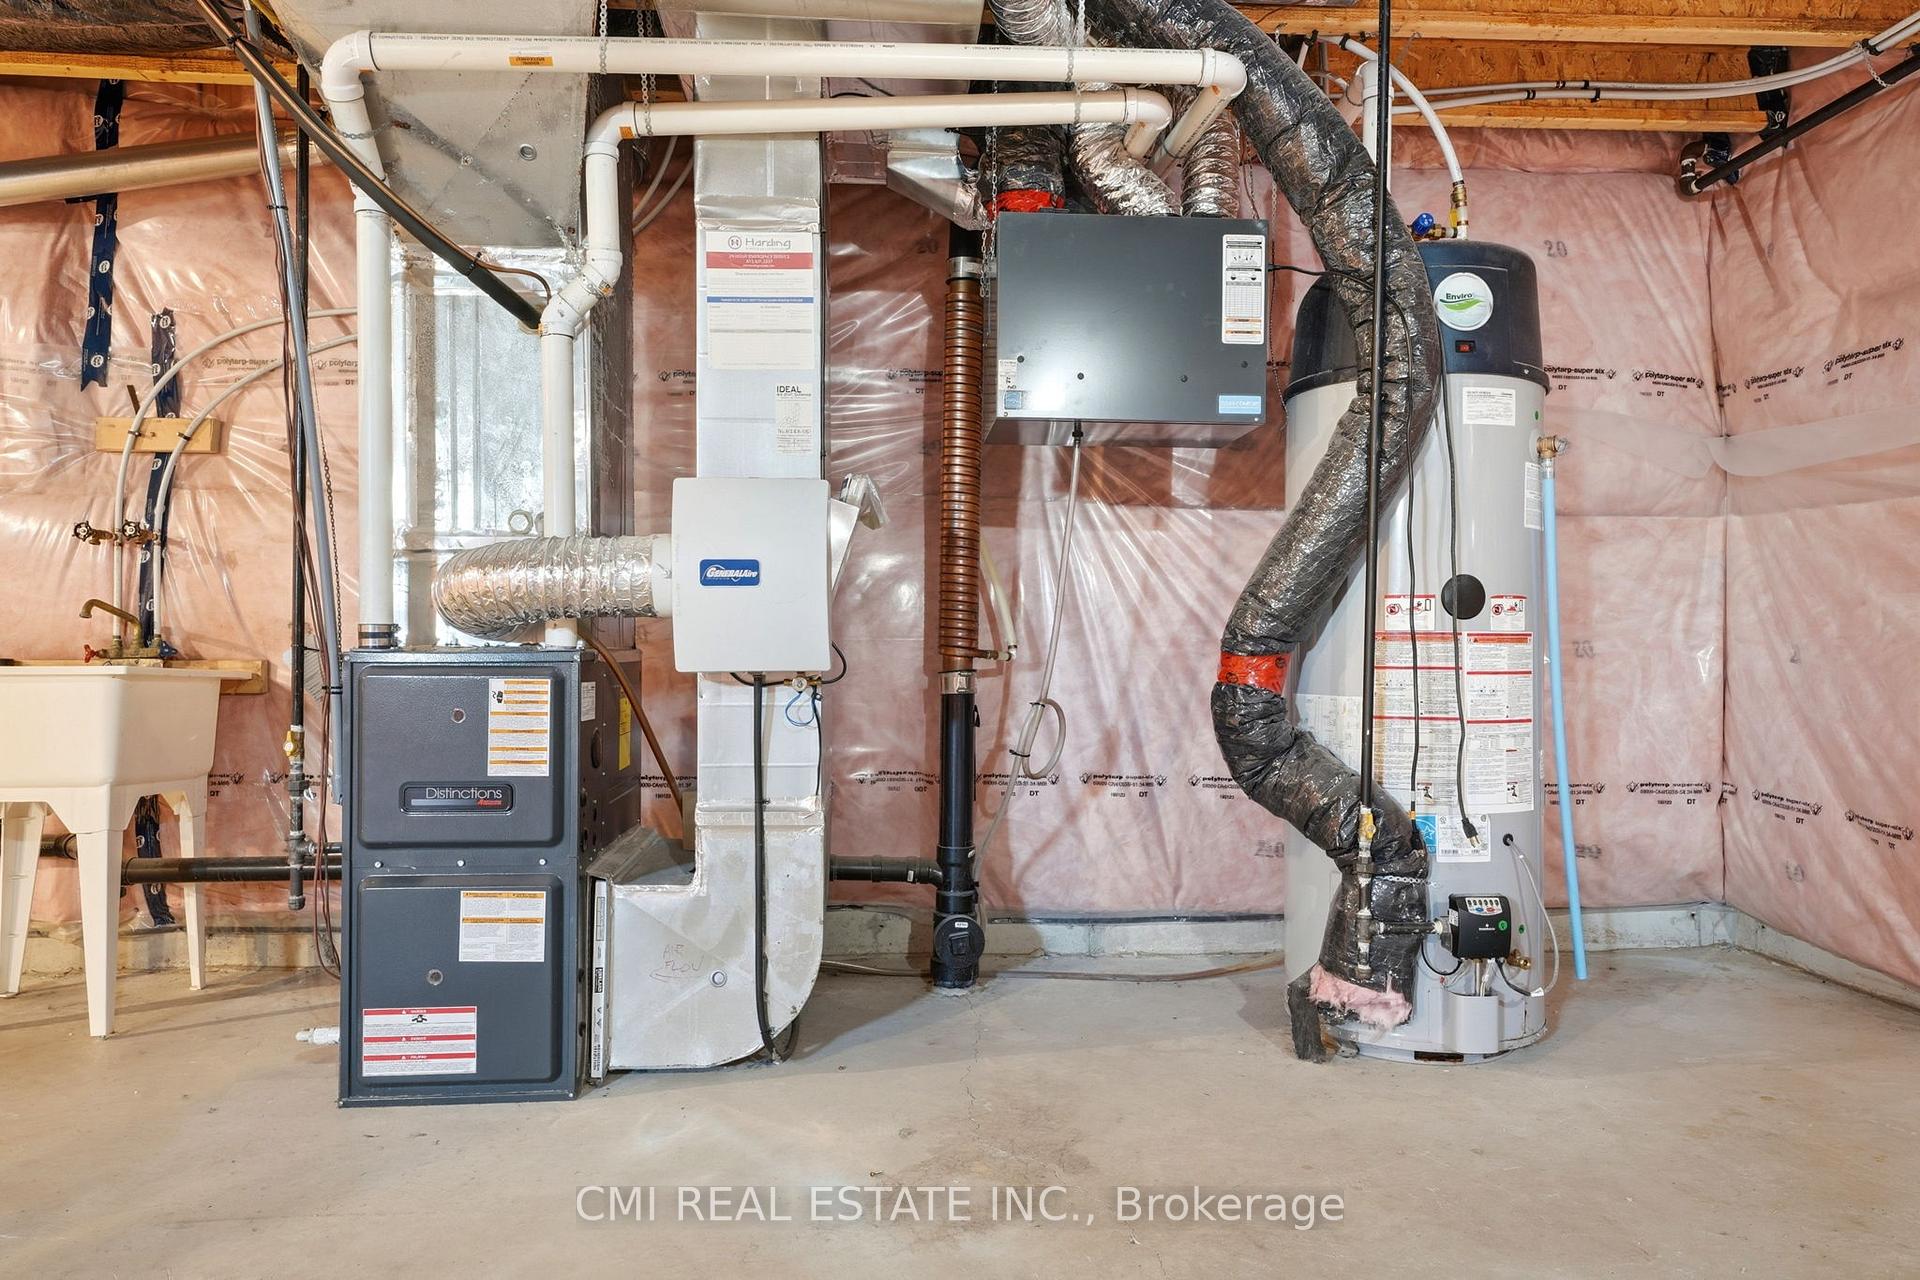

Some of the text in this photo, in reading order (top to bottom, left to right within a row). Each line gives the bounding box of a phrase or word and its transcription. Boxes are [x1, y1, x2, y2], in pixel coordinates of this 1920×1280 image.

[746, 238, 791, 249] Harding
[1446, 292, 1473, 300] Enviro
[776, 385, 802, 393] IDEAL
[425, 787, 502, 799] Distinctions
